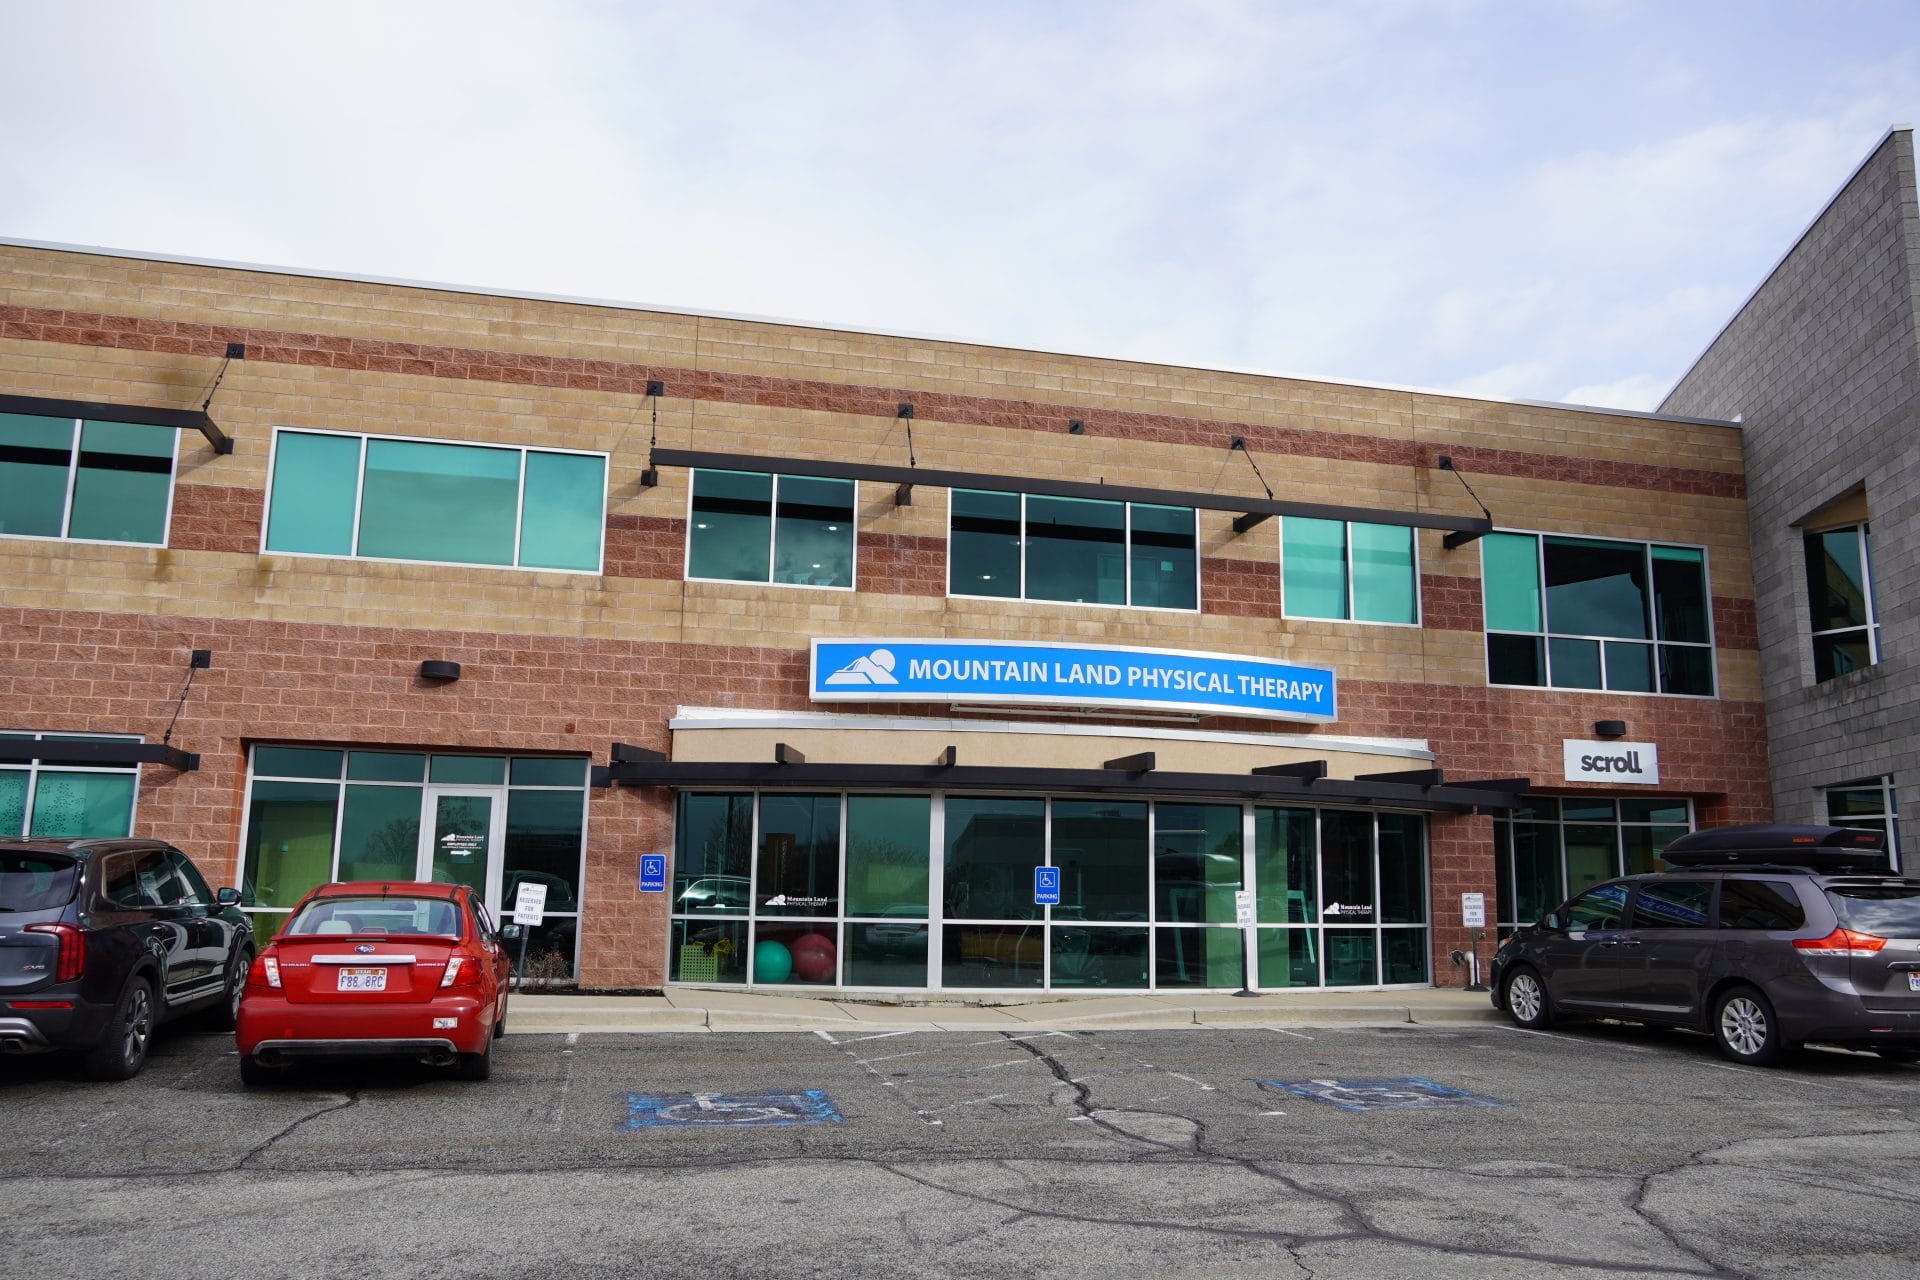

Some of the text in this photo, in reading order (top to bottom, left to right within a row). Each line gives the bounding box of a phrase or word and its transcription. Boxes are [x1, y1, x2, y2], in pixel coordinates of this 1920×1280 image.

[908, 659, 1324, 703] MOUNTAIN LAND PHYSICAL THERAPY
[1581, 750, 1643, 774] scroll
[519, 896, 542, 905] RESERVED
[518, 912, 540, 920] PATIENTS
[340, 975, 359, 988] F88
